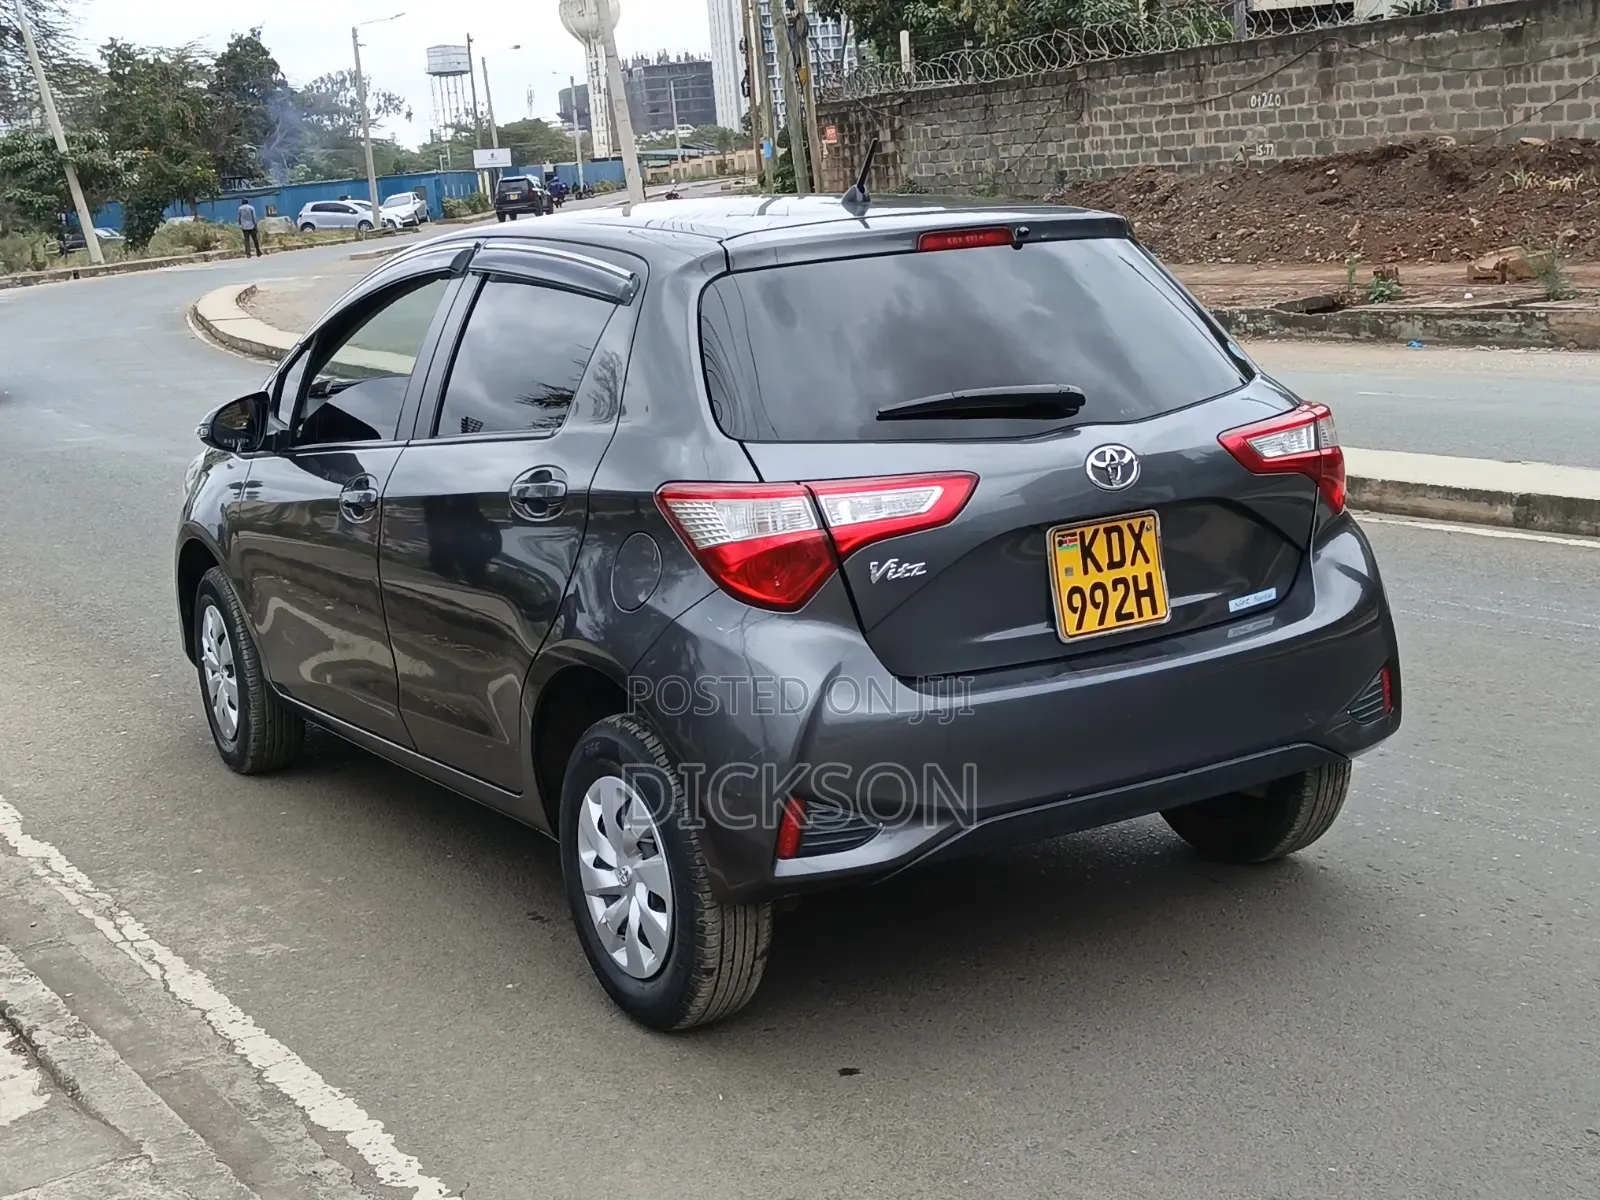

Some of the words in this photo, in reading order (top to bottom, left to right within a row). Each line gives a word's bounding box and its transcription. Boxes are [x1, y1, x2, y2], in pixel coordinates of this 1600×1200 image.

[870, 558, 927, 584] Vitz
[1079, 520, 1150, 576] KDX
[1066, 571, 1159, 631] 992H
